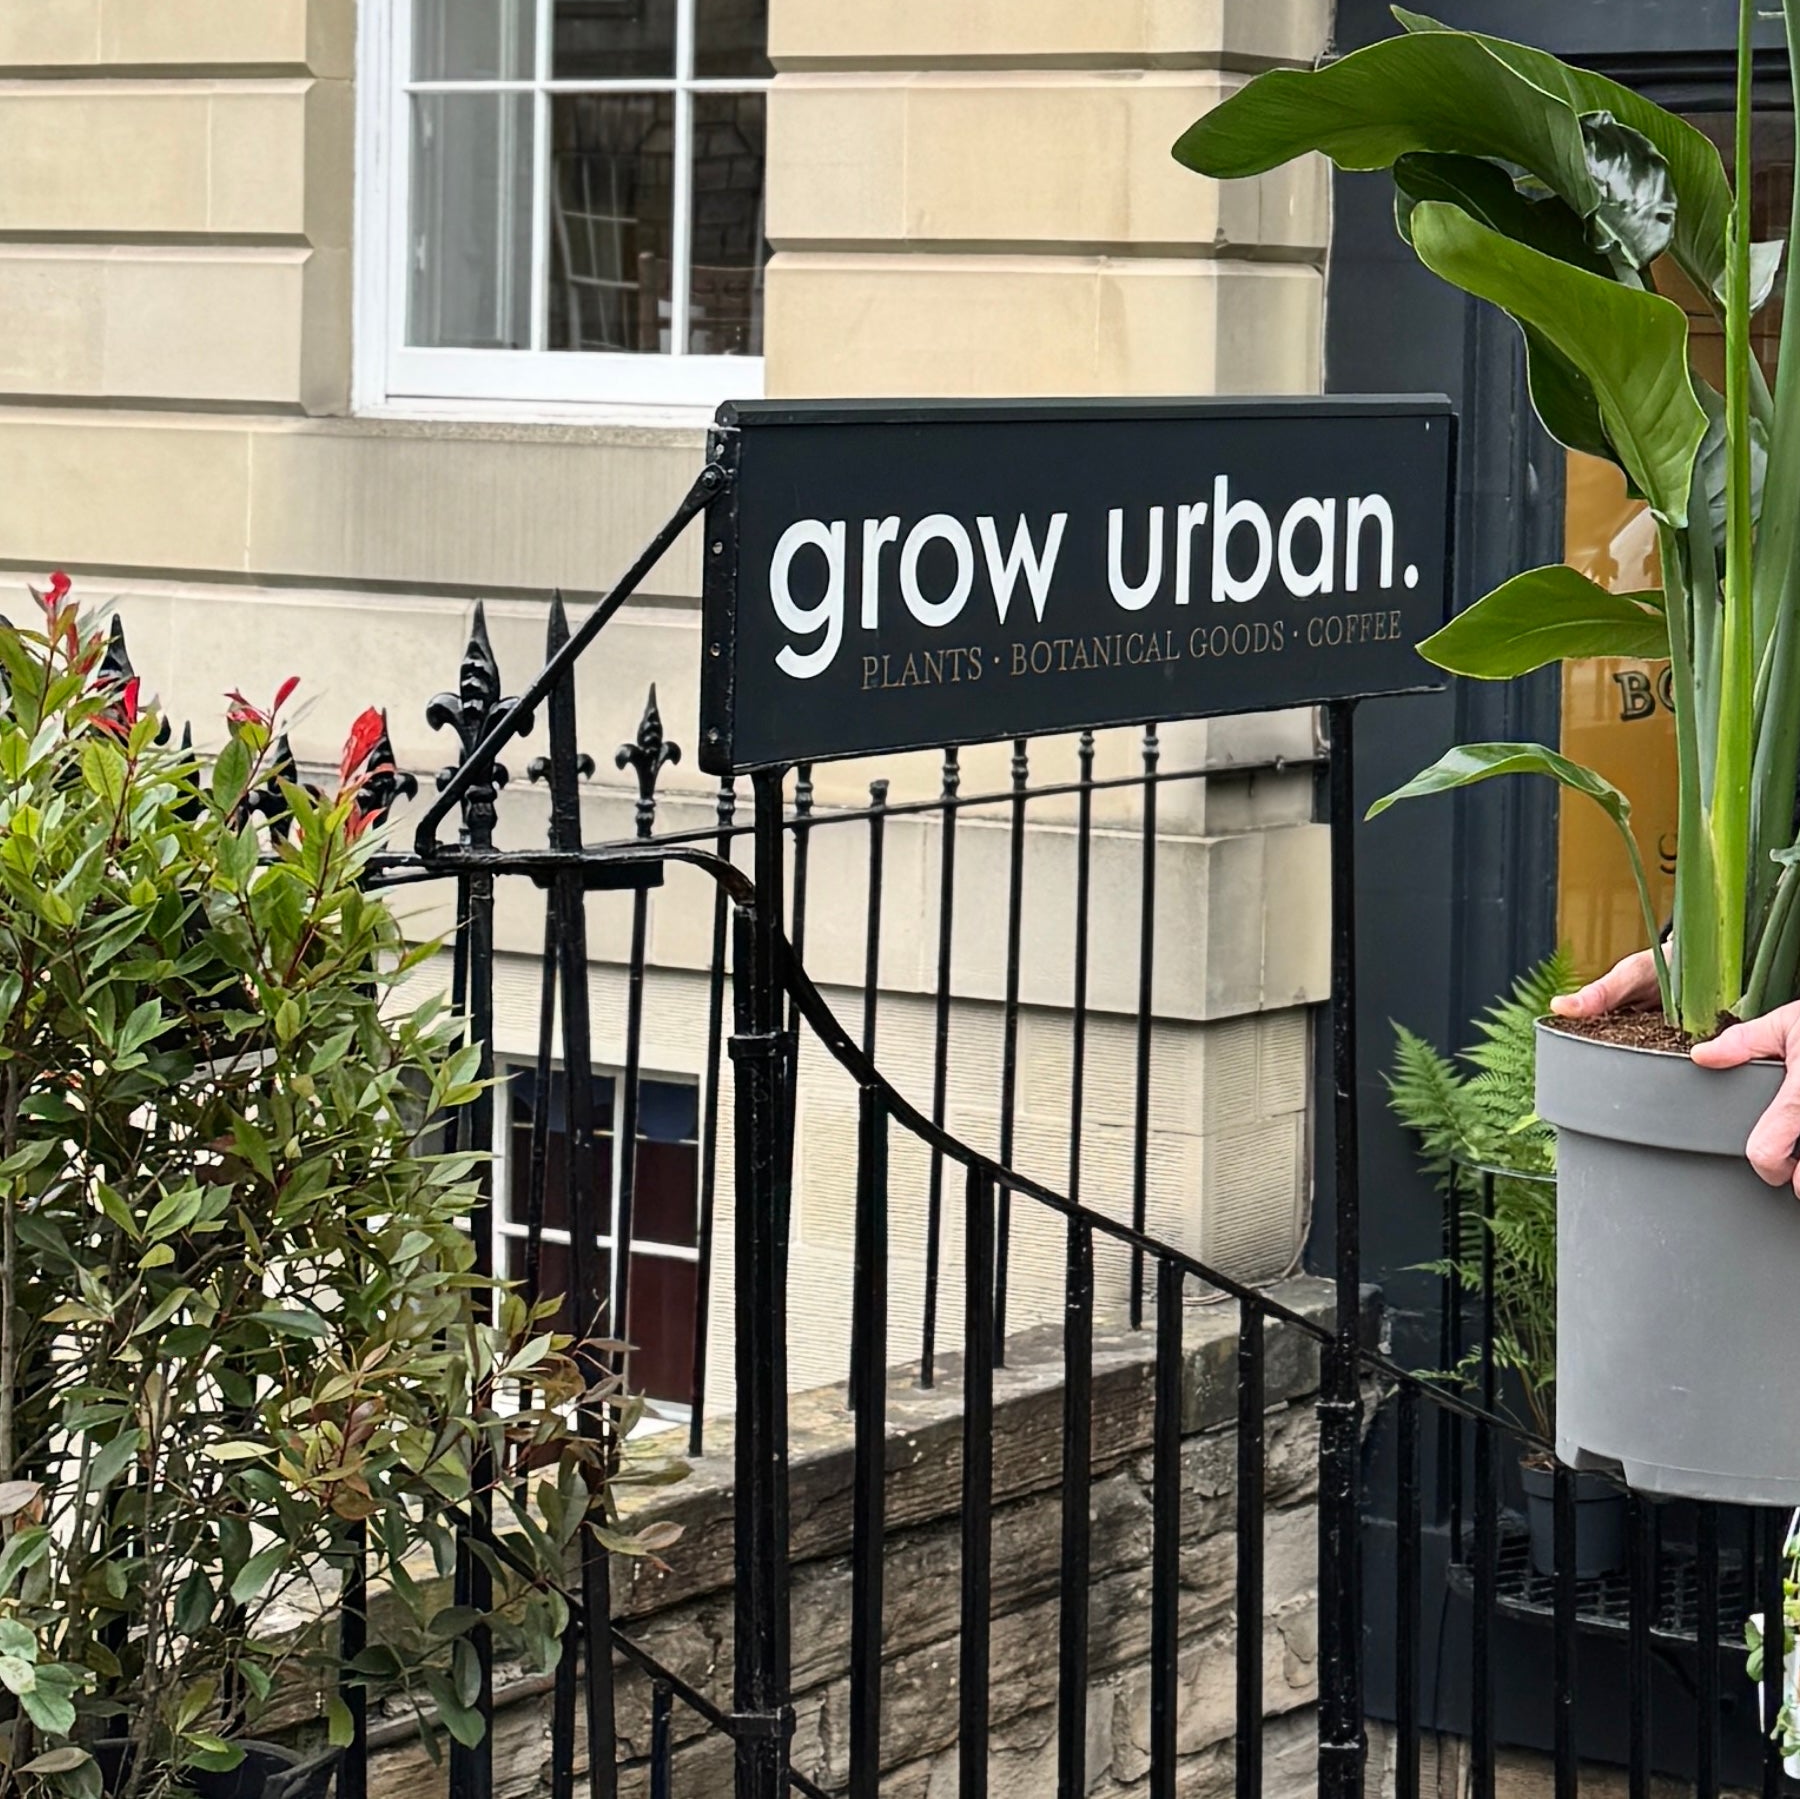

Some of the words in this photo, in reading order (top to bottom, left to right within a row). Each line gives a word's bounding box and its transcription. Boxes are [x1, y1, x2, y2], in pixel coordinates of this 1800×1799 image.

[769, 512, 1068, 679] grow
[1107, 474, 1420, 611] urban.
[861, 646, 982, 690] PLANTS
[1010, 630, 1180, 676] BOTANICAL
[1190, 620, 1284, 658] GOODS
[1307, 610, 1401, 647] COFFEE
